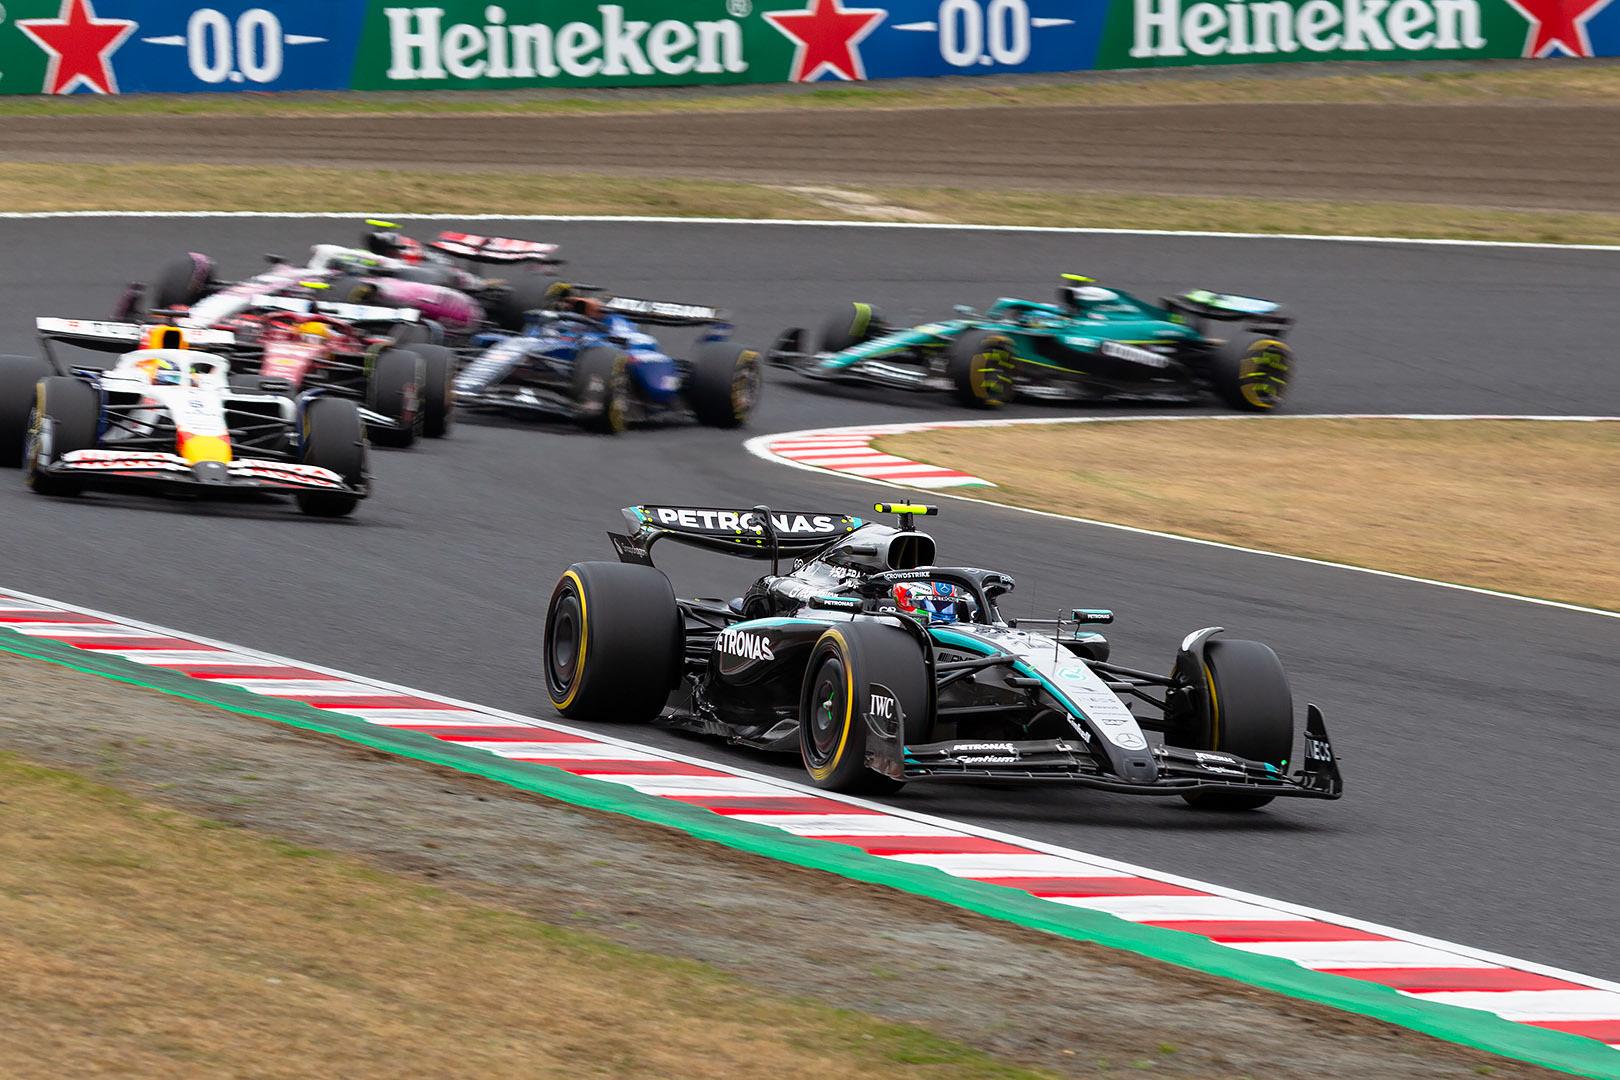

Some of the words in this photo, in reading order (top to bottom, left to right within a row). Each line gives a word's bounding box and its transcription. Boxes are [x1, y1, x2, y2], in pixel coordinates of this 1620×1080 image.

[187, 8, 283, 83] 0.0
[386, 4, 748, 81] Heineken
[939, 0, 1030, 67] 0.0
[1129, 0, 1488, 57] Heineken
[886, 571, 931, 580] CROWDSTRIKE
[823, 600, 854, 608] PETRONAS
[869, 694, 895, 719] IWC
[953, 742, 1016, 754] PETRONAS
